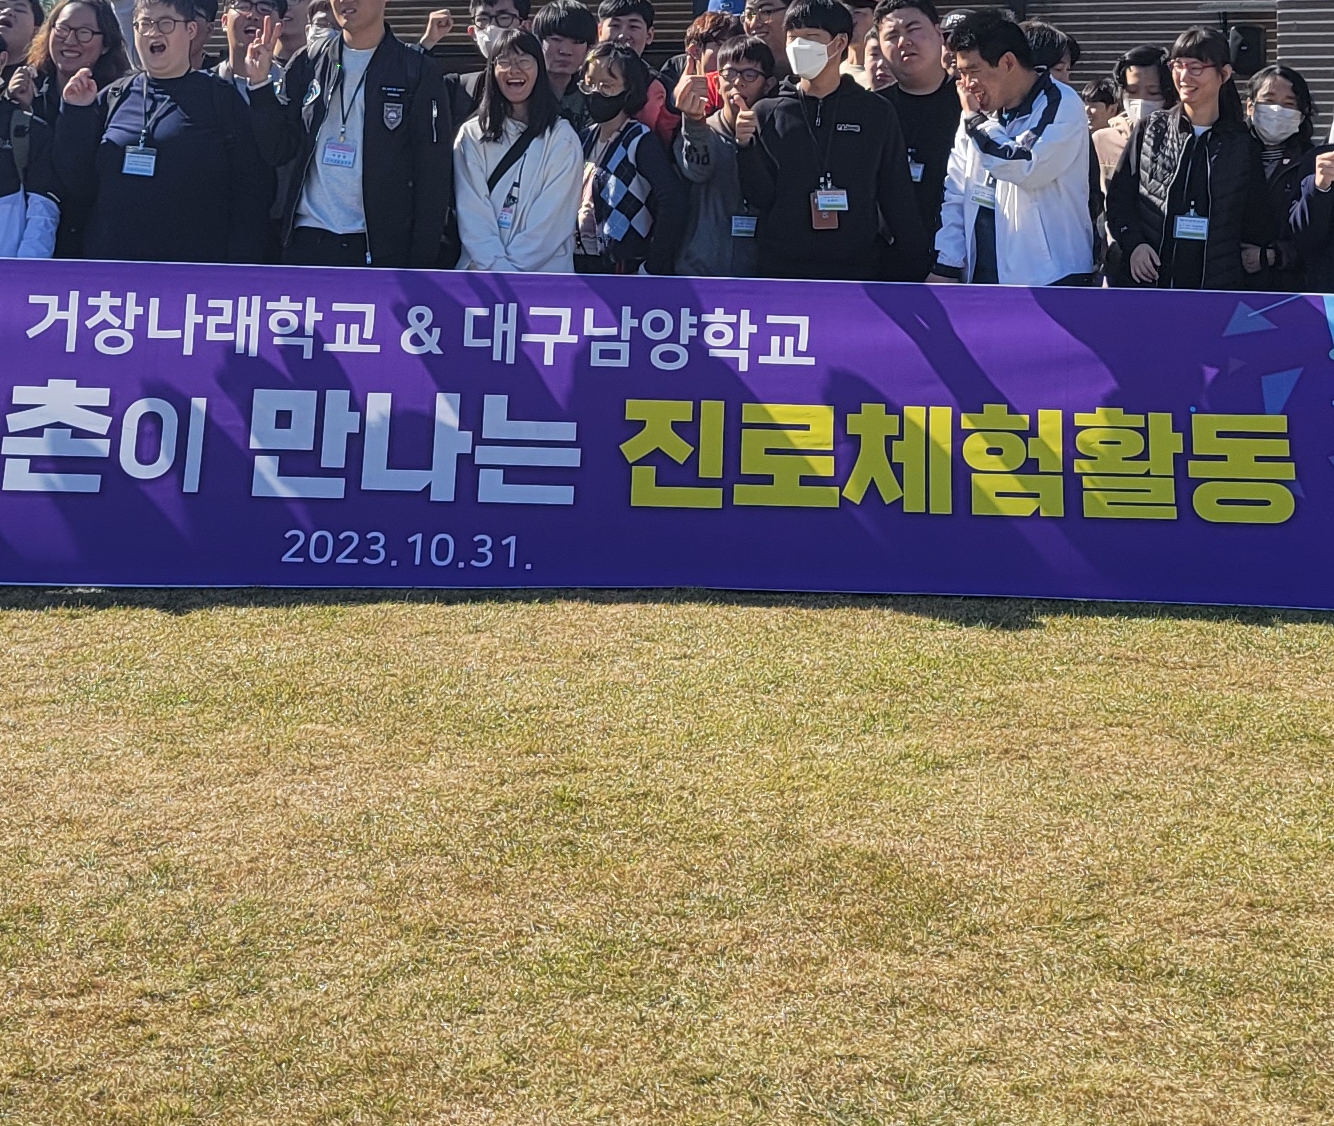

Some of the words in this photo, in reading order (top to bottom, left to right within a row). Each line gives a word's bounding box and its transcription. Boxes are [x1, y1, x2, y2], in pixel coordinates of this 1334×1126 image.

[26, 291, 380, 359] 거창나래학교
[401, 304, 444, 356] &
[464, 303, 816, 372] 대구남양학교
[250, 388, 582, 505] 만나는
[618, 398, 1297, 525] 진로체험활동
[280, 529, 535, 571] 2023.10.31.
